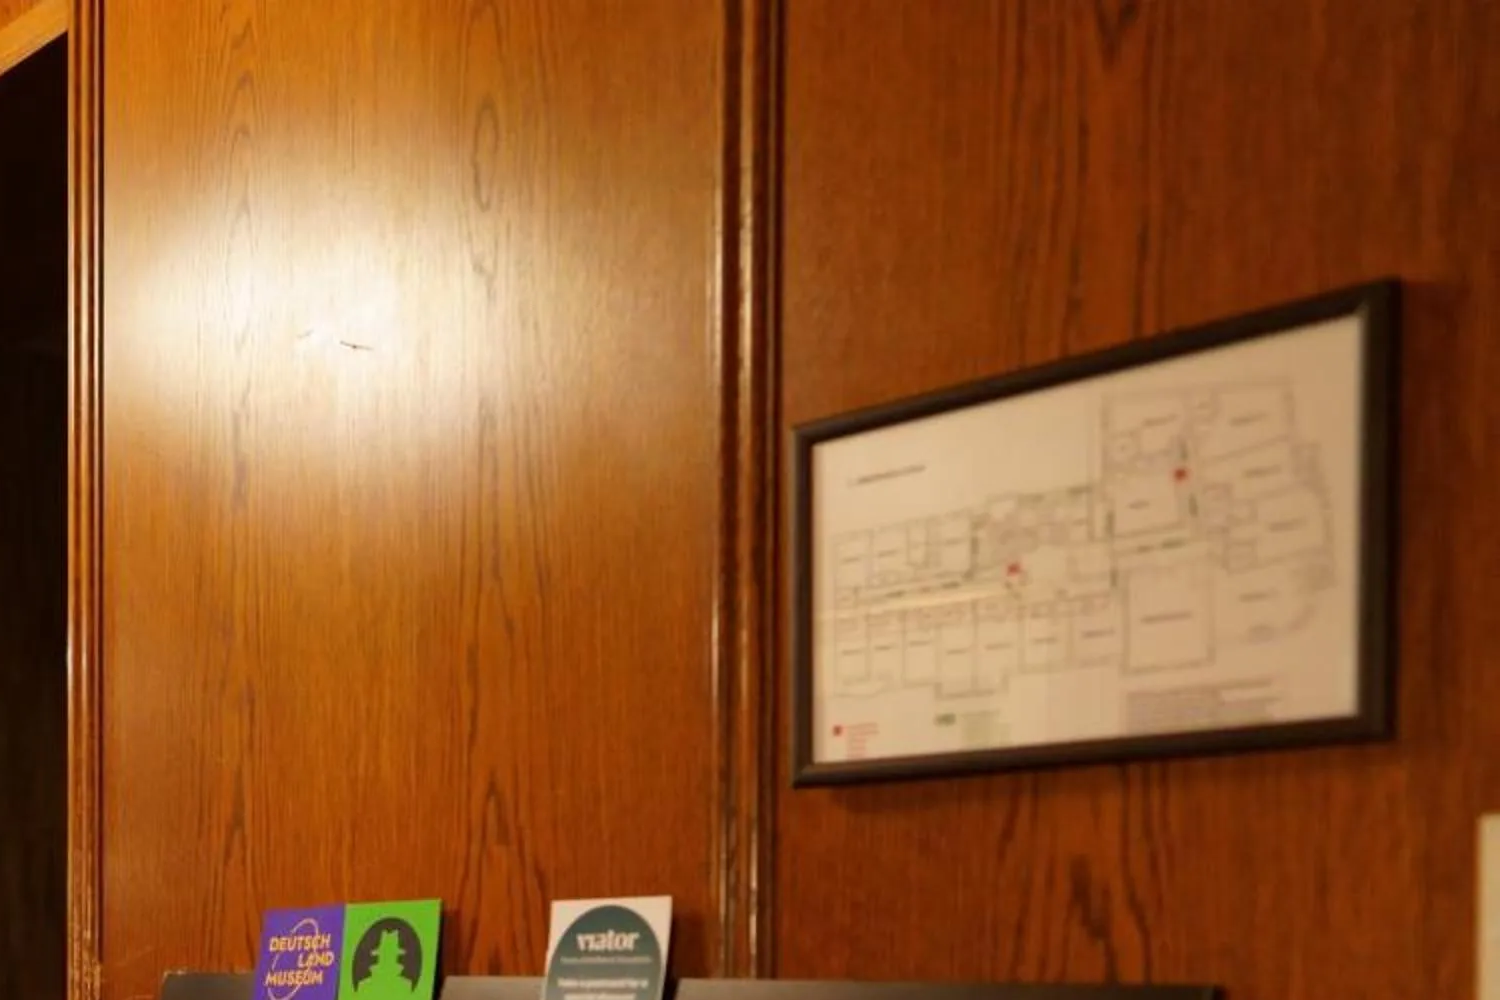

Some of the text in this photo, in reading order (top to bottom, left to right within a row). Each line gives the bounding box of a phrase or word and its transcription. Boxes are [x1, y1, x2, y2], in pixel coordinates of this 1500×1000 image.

[268, 932, 331, 952] DEUTSCH
[576, 929, 640, 951] viator
[298, 951, 335, 968] LAND
[264, 970, 324, 987] MUSEUM
